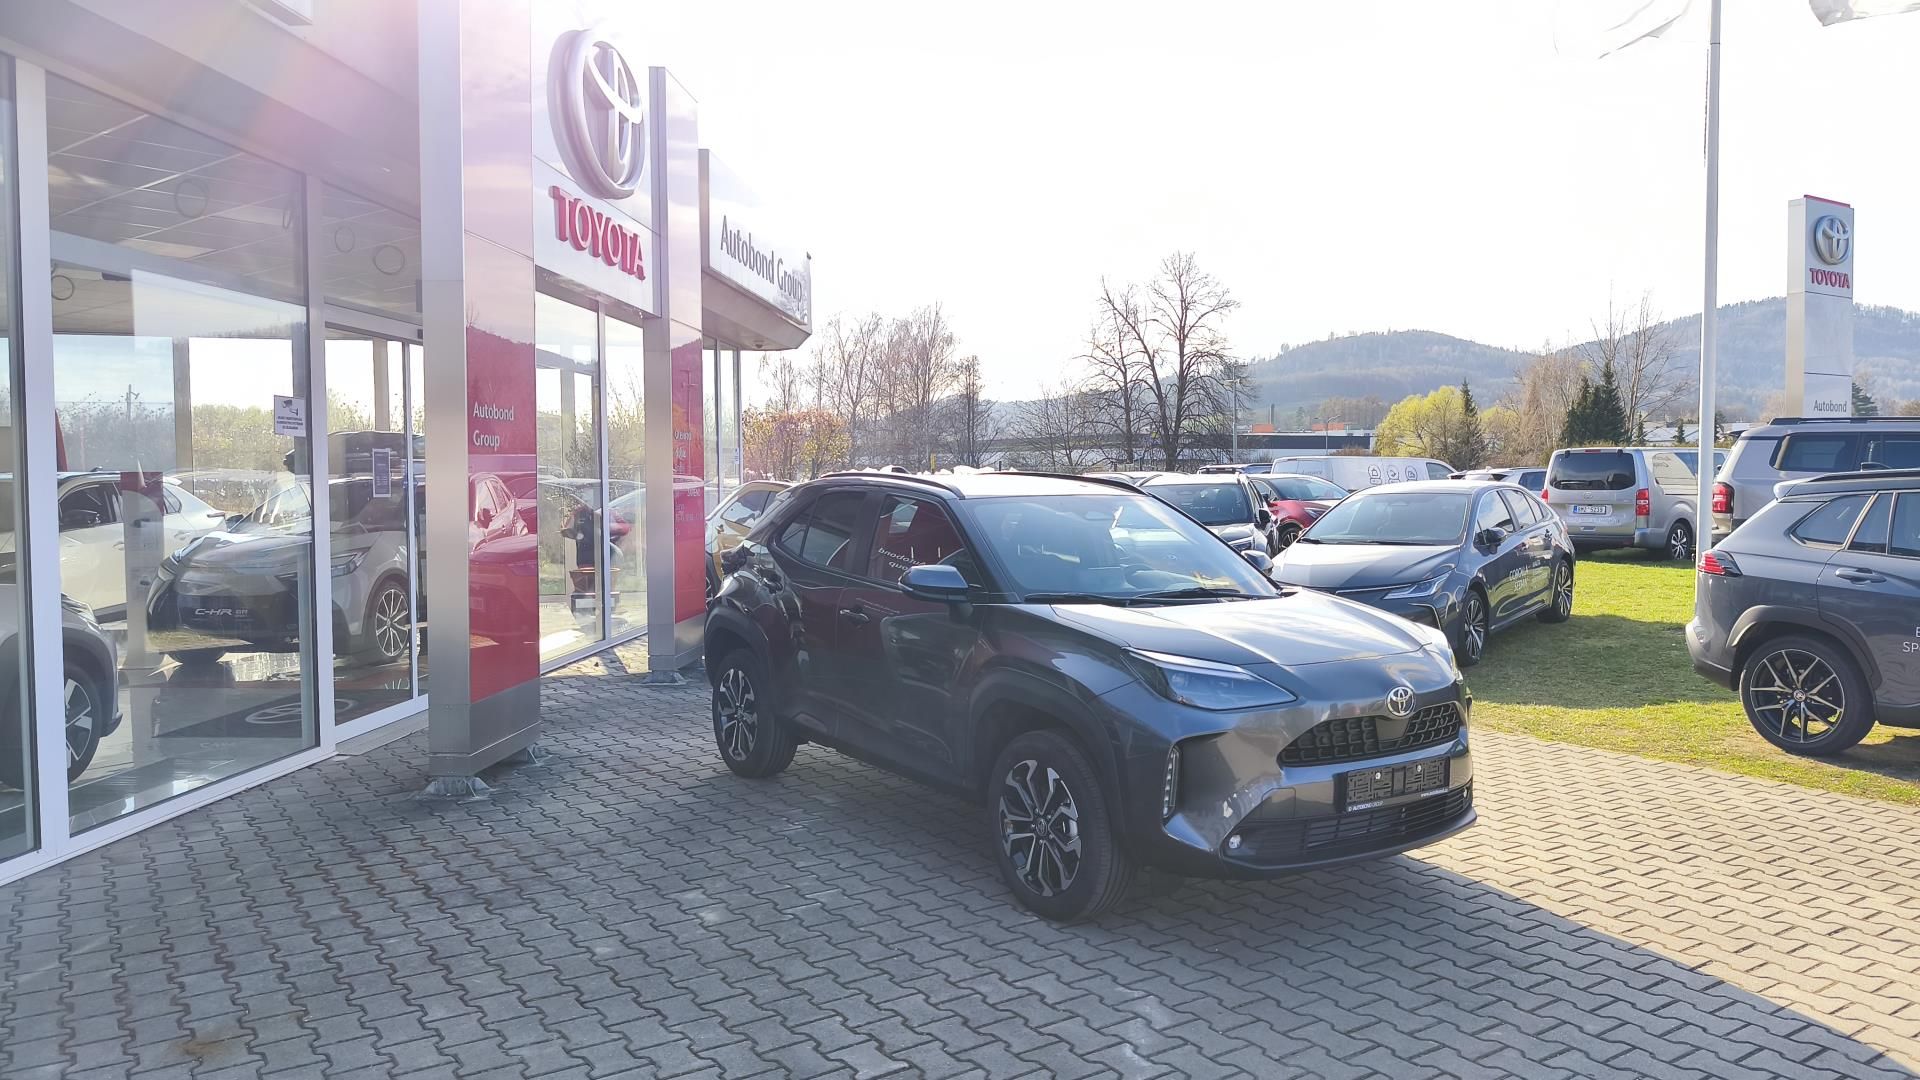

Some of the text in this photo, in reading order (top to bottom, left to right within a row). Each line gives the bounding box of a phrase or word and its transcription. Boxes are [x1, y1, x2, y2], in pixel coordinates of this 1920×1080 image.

[548, 185, 646, 281] TOYOTA
[720, 214, 803, 312] Autobond Group
[1809, 267, 1850, 289] TOYOTA
[473, 401, 514, 421] Autobond
[1813, 400, 1848, 413] Autobond
[473, 430, 501, 452] Group
[195, 608, 233, 616] C-HR
[1902, 641, 1920, 653] SP
